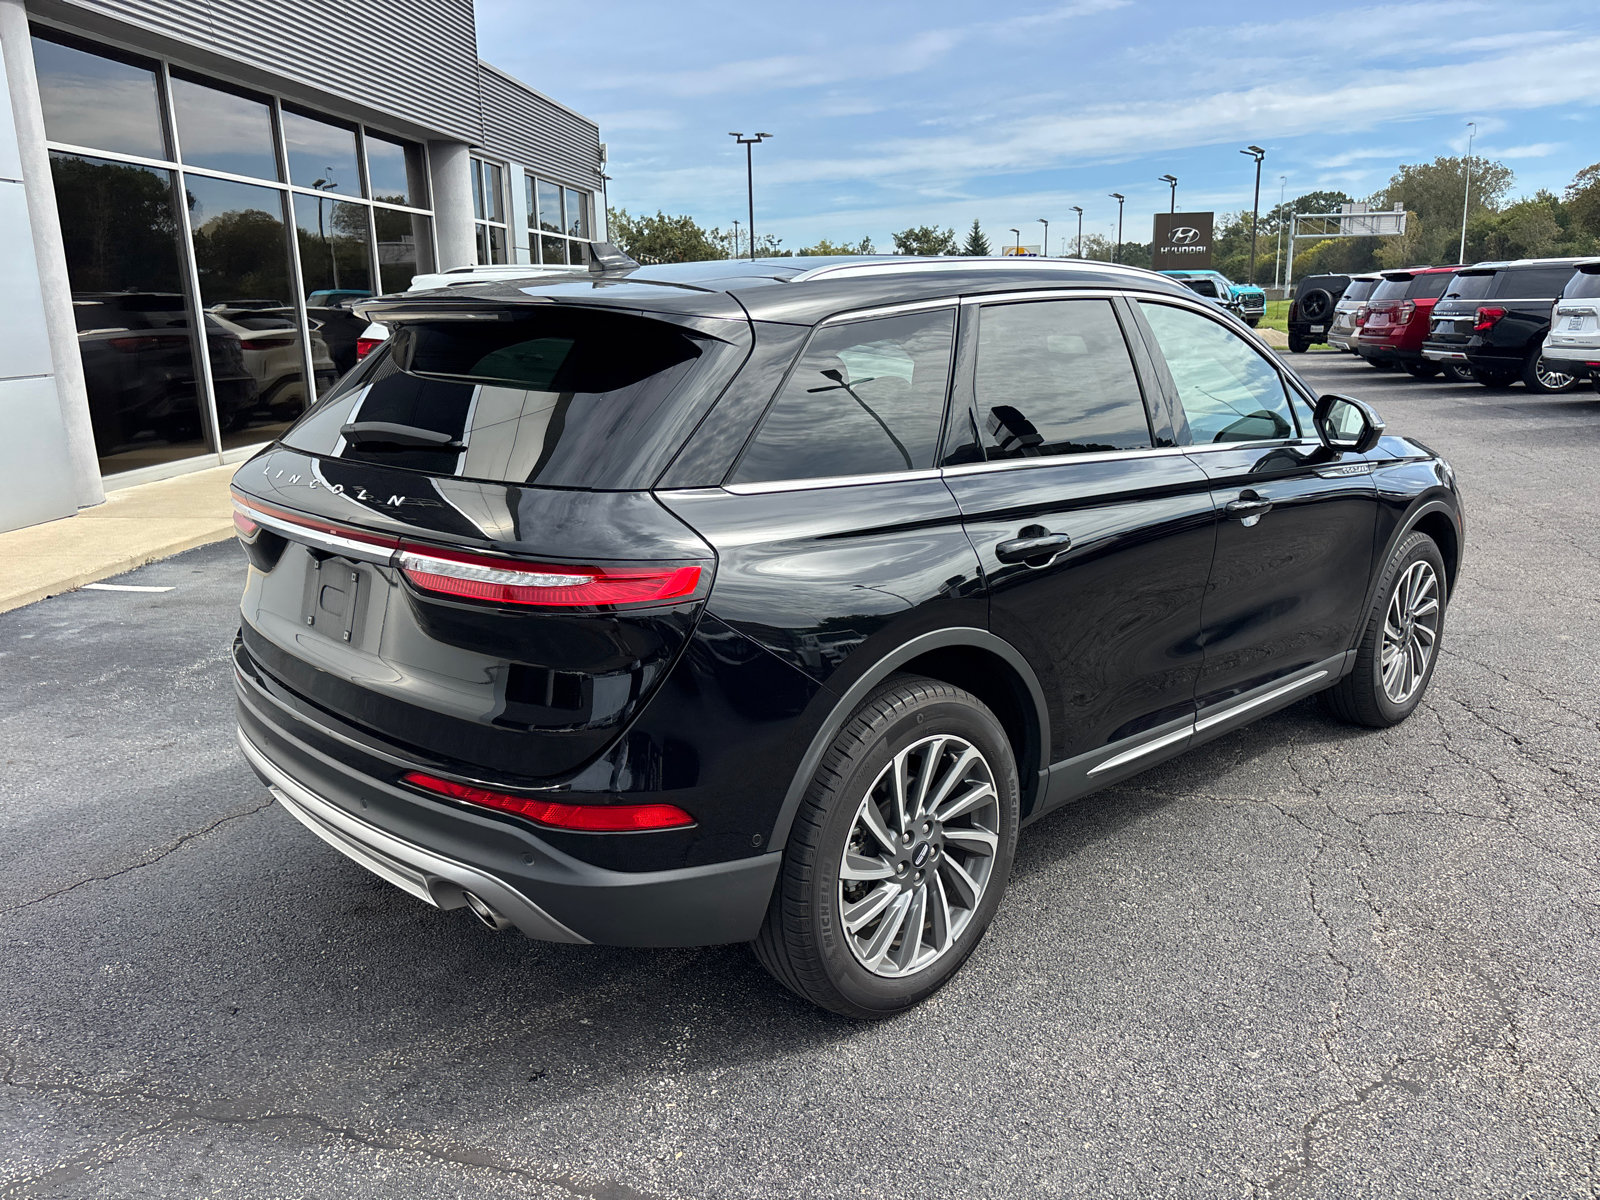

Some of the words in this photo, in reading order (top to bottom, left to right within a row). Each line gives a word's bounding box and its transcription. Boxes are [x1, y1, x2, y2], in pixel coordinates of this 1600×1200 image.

[1160, 245, 1207, 255] HYUNDAI
[263, 466, 406, 507] LINCOLN
[819, 862, 835, 949] MICHELIN
